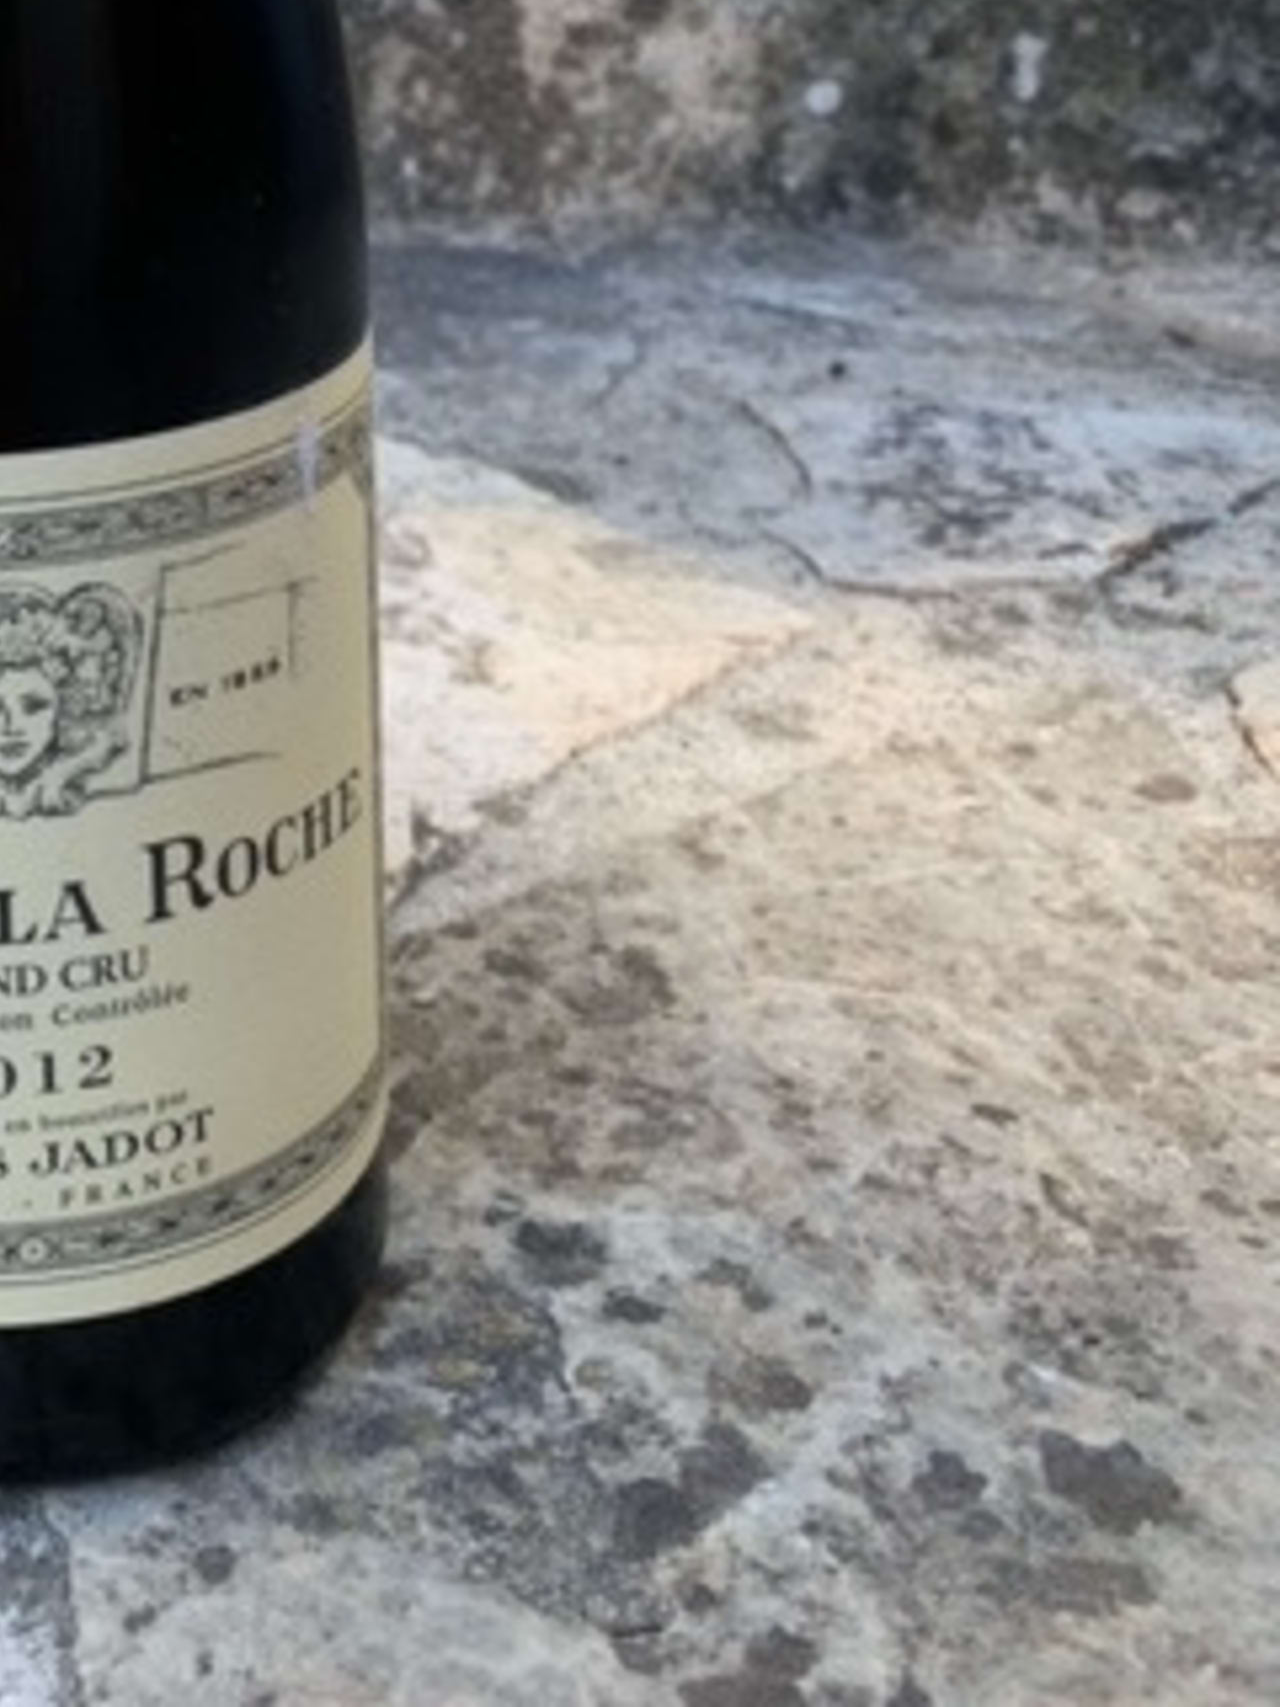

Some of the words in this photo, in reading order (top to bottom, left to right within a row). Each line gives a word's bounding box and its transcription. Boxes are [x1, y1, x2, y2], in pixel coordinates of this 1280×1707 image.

[142, 767, 362, 924] ROCHE
[58, 945, 150, 992] CRU
[28, 1106, 215, 1176] JADOT
[60, 1155, 212, 1210] FRANCE
